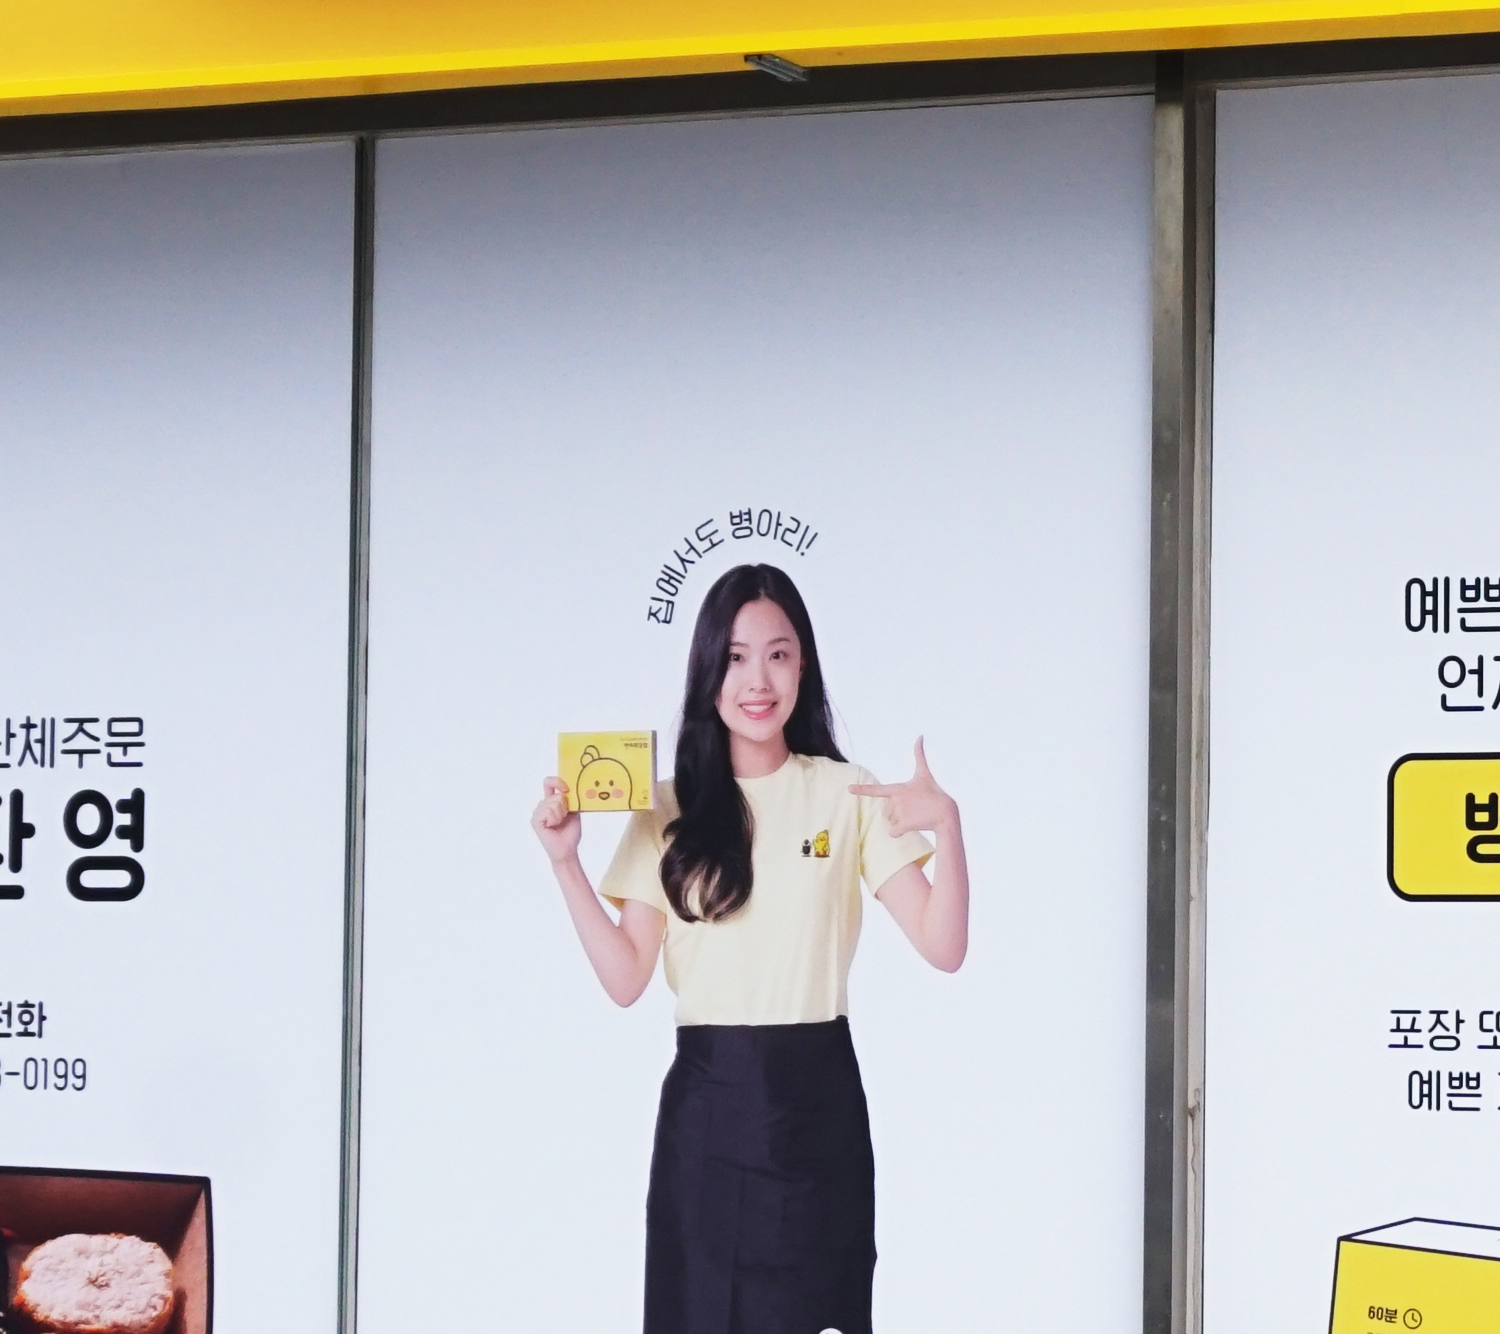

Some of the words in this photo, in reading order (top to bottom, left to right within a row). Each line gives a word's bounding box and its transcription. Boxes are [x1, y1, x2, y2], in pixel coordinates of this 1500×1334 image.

[646, 517, 726, 625] 집에서도
[729, 507, 819, 557] 병아리!
[1386, 1008, 1467, 1053] 포장
[1406, 1070, 1484, 1113] 예쁜
[1367, 1305, 1399, 1324] 60분
